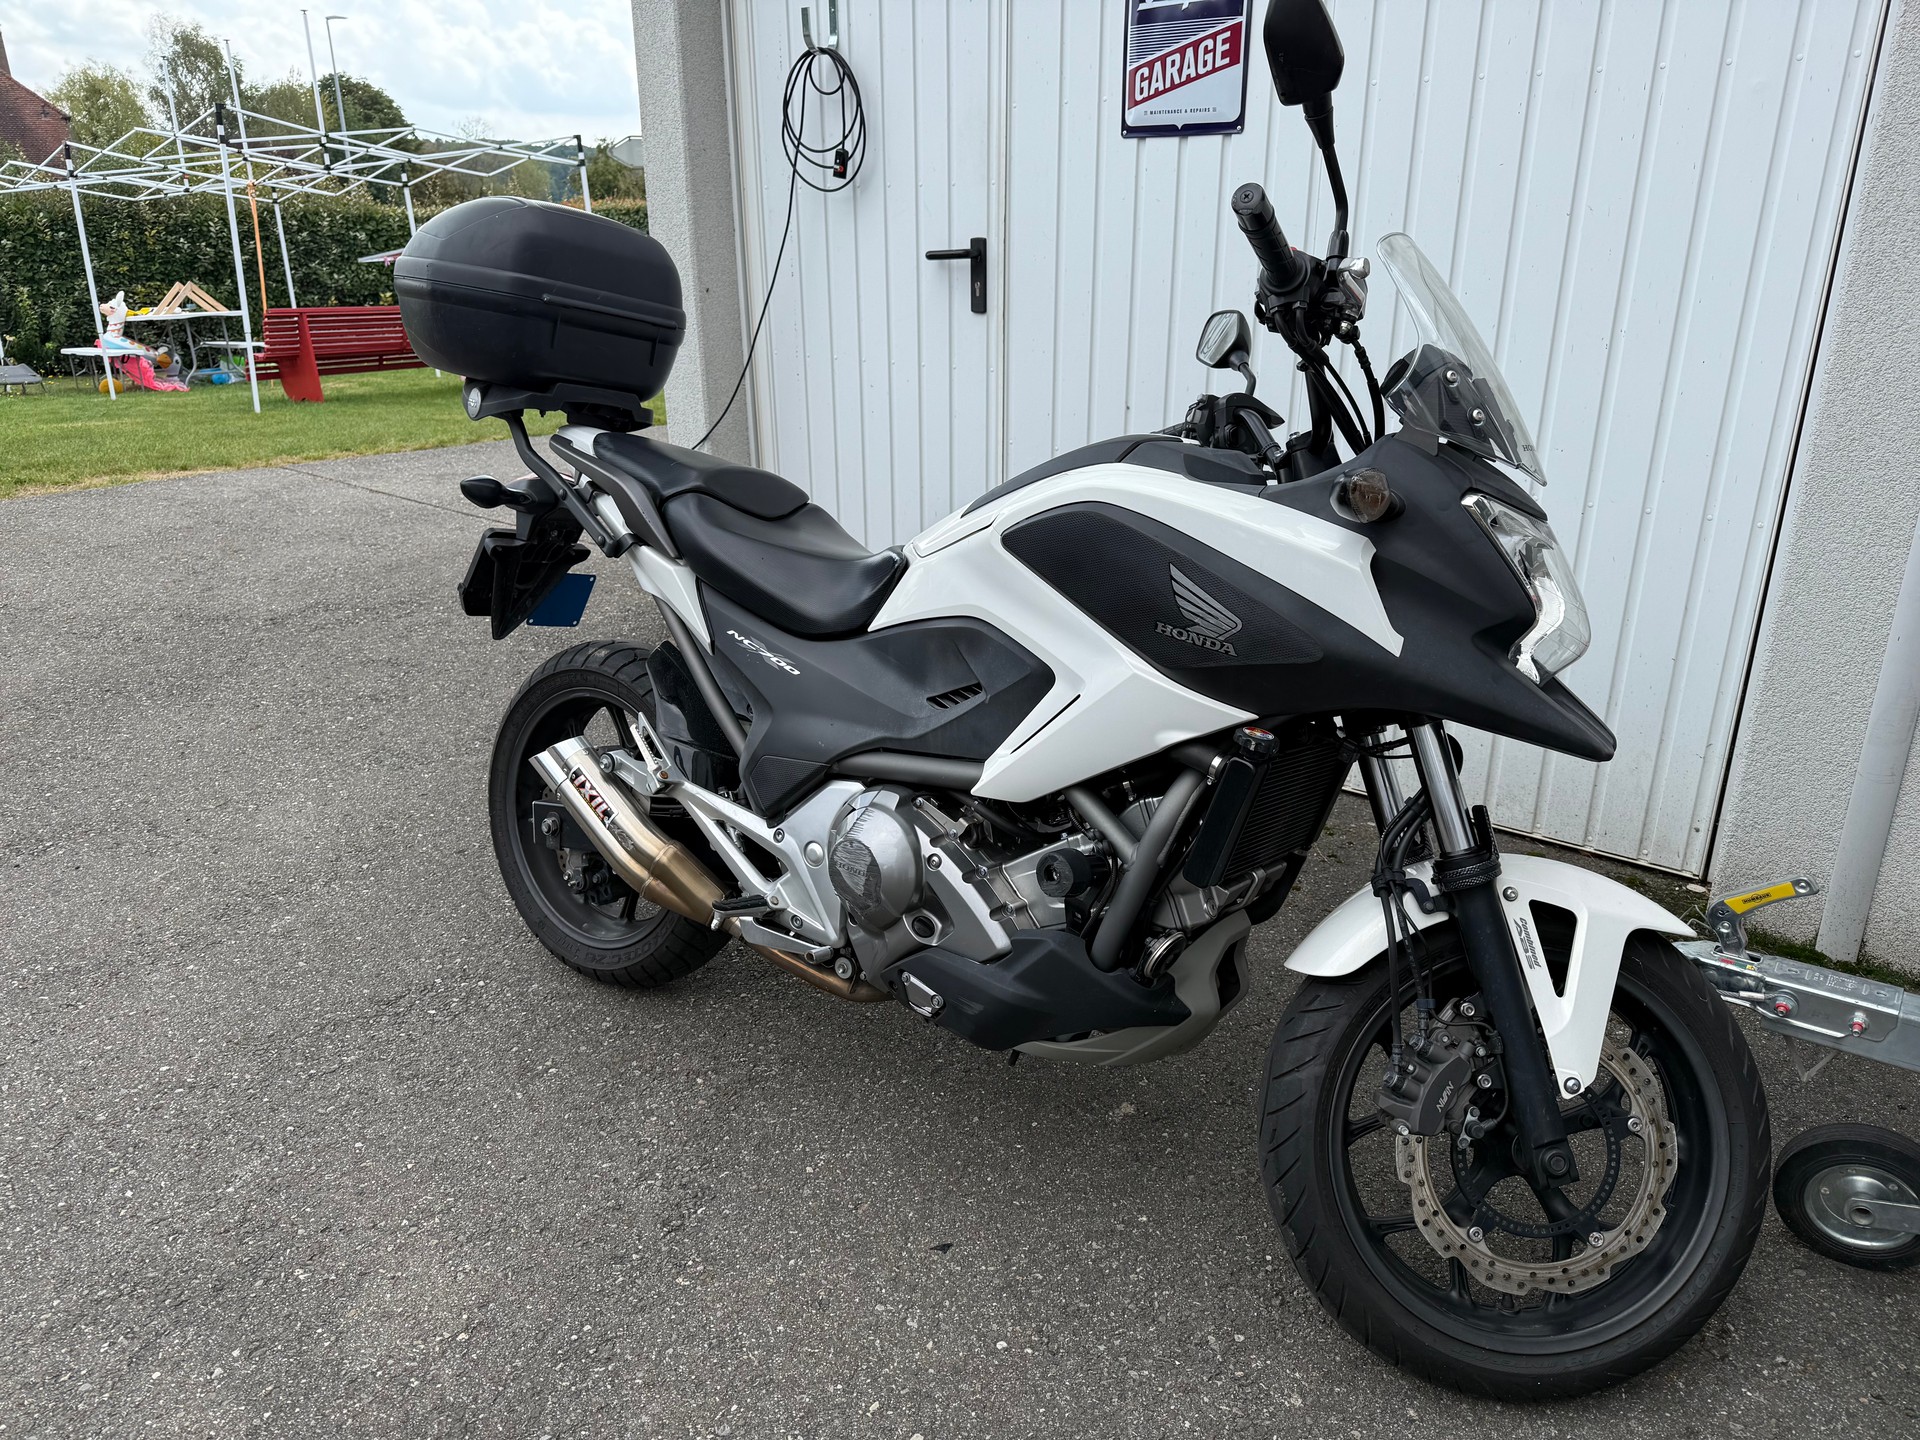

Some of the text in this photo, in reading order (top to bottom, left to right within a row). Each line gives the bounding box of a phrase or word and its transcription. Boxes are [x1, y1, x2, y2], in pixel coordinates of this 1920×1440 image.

[1134, 31, 1231, 102] GARAGE
[1155, 621, 1238, 657] HONDA
[573, 774, 609, 820] IXIL
[1512, 918, 1536, 970] ABS
[1519, 917, 1542, 968] Combined
